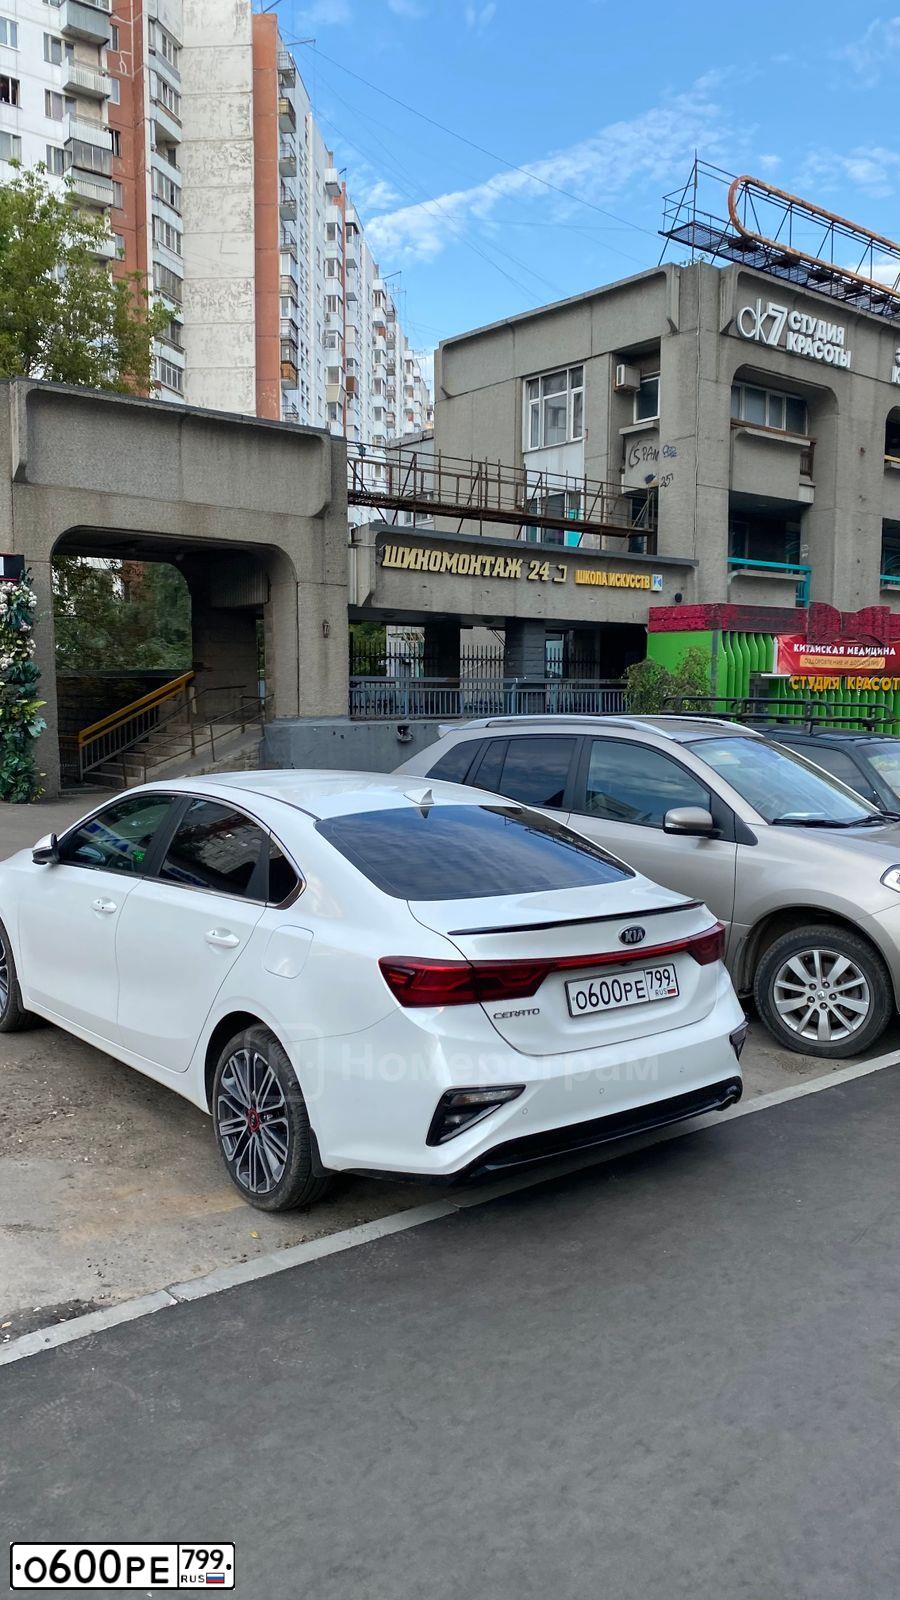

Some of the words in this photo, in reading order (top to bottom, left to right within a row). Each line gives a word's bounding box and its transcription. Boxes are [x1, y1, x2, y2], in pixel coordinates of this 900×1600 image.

[788, 311, 845, 345] СТУДИЯ
[787, 332, 851, 368] КРАСОТЫ
[382, 545, 523, 579] ШИНОМОНТАЖ
[528, 560, 550, 581] 24
[576, 570, 607, 586] ШКОЛА
[607, 573, 650, 589] ИСКУССТВ
[847, 646, 896, 656] МЕДИЦИНА
[791, 676, 840, 692] СТУДИЯ
[624, 927, 645, 943] KIA
[646, 968, 671, 990] 799
[493, 1008, 540, 1019] CERATO
